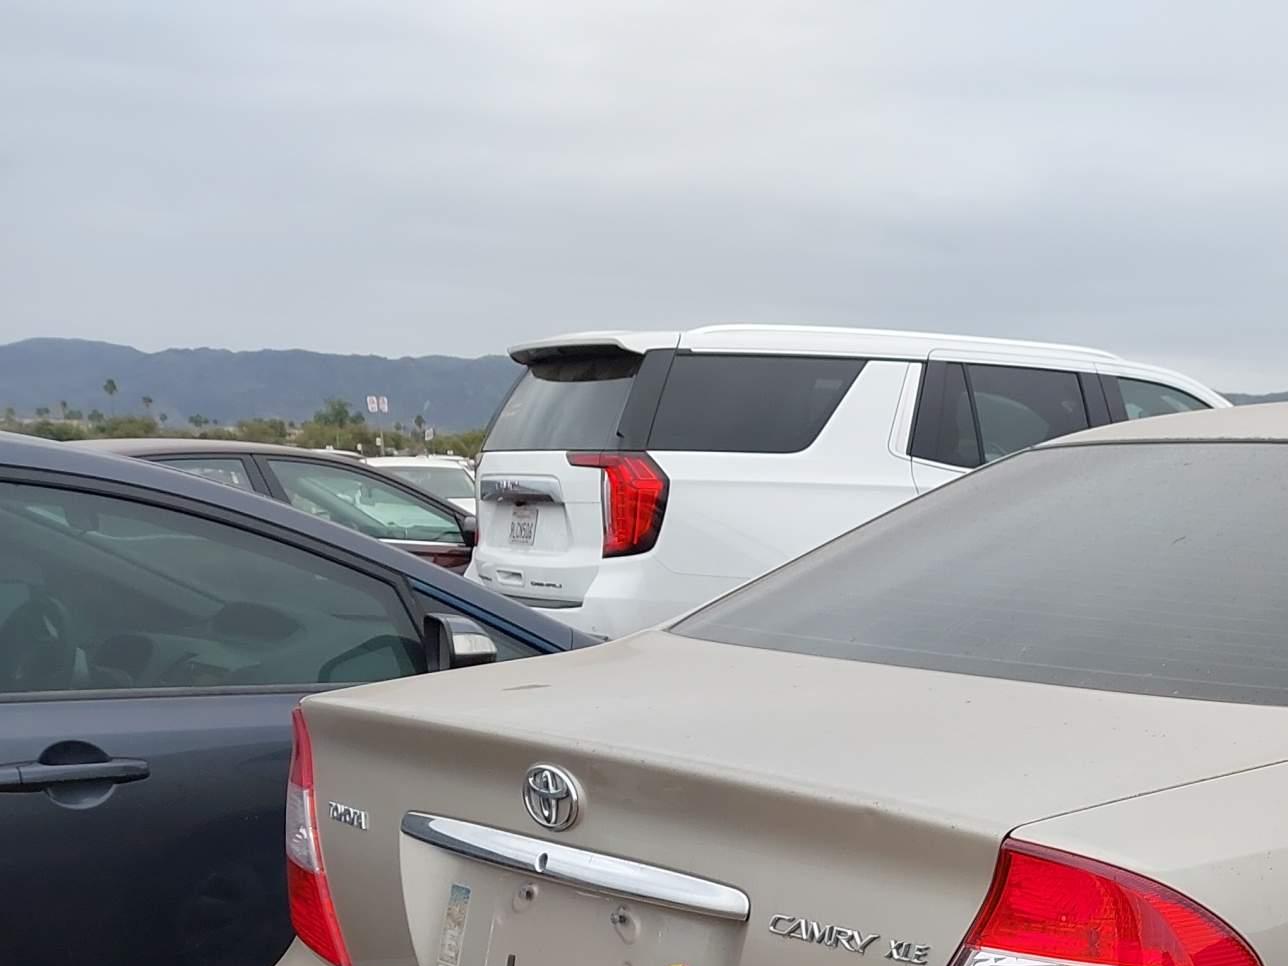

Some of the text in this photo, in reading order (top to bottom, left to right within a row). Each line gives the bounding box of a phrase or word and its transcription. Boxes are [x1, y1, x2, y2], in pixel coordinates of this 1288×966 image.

[328, 800, 369, 831] TOYOTA
[768, 913, 932, 966] CAMRY XLE
